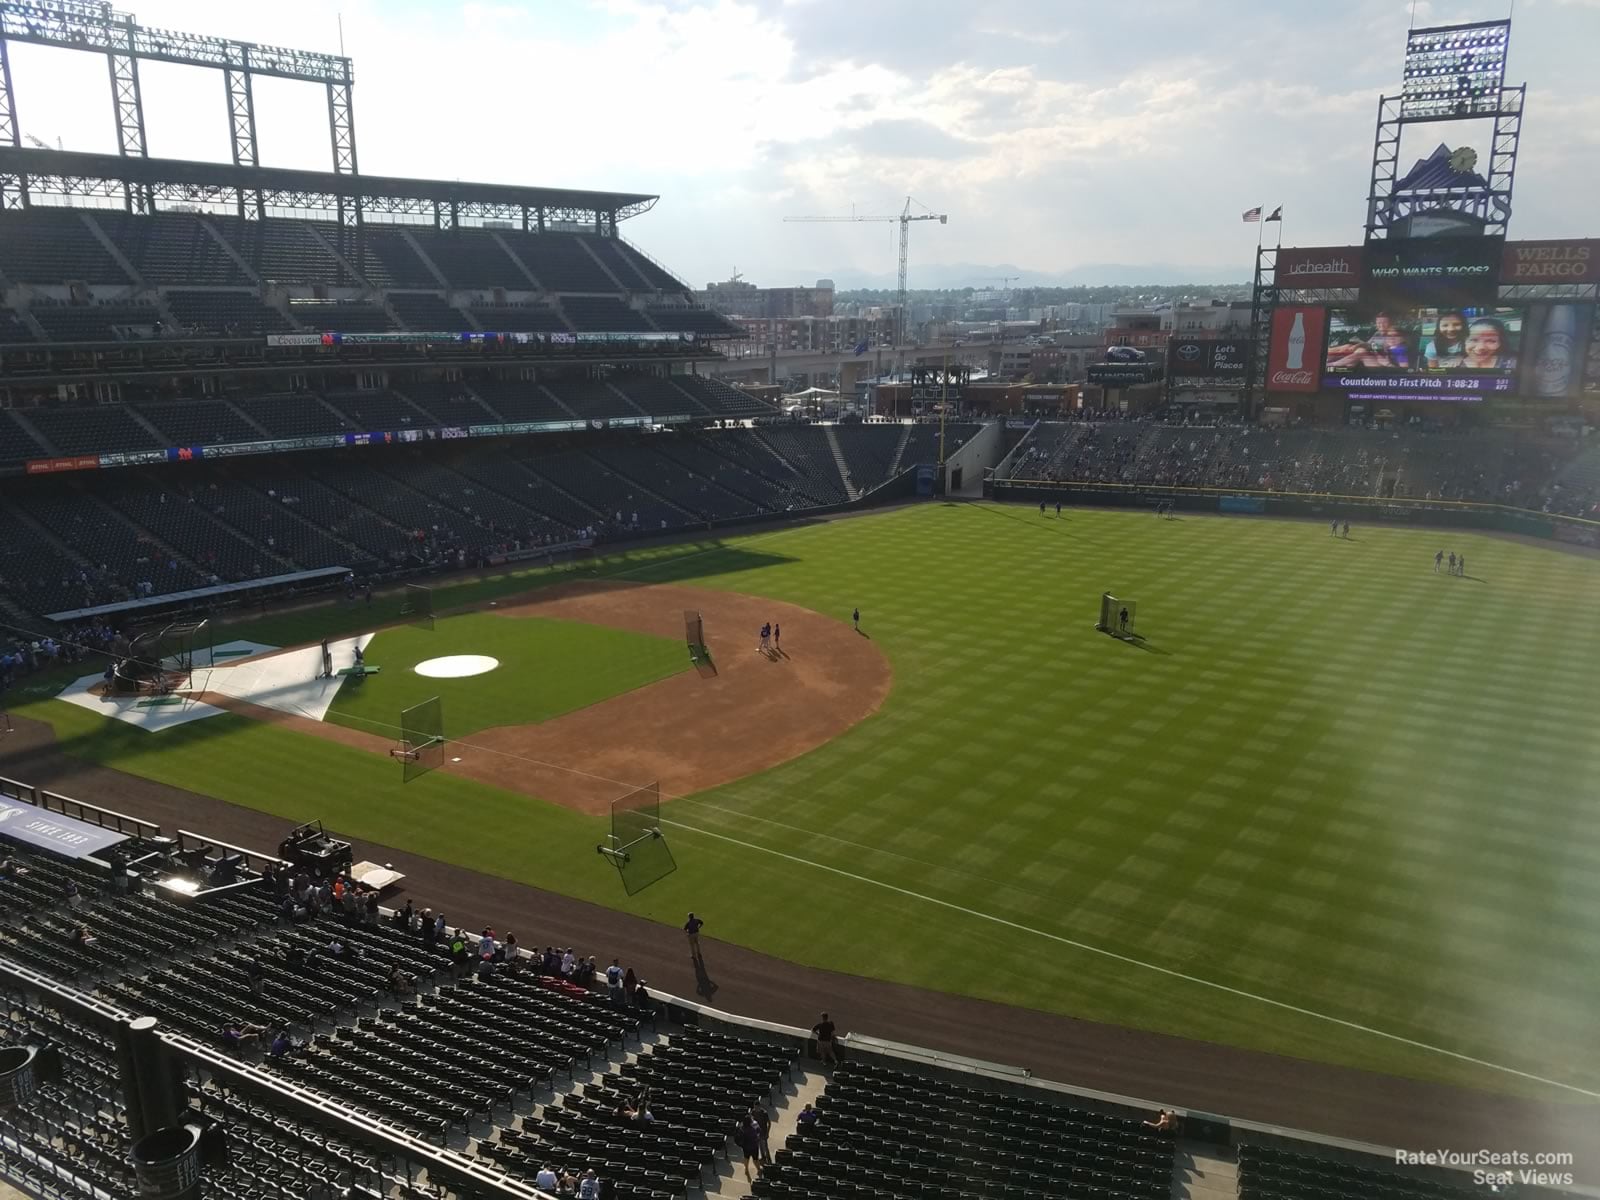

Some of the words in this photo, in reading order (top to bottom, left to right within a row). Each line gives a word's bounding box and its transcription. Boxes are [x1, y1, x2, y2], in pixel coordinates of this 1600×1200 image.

[1516, 247, 1590, 261] WELLS
[1289, 257, 1349, 273] uchealth
[1371, 267, 1400, 278] WHO
[1402, 266, 1443, 277] WANTS
[1446, 265, 1490, 276] TACOS?
[1514, 262, 1588, 276] FARGO
[301, 336, 321, 345] LIGHT
[1215, 344, 1237, 353] Let's
[1214, 353, 1228, 361] Go
[1214, 361, 1244, 369] Places
[1340, 376, 1387, 387] Countdown
[1388, 378, 1398, 387] to
[1399, 377, 1418, 388] First
[1419, 377, 1442, 388] Pitch
[1446, 379, 1480, 389] 1:08:28
[25, 821, 61, 836] SINCE
[56, 831, 89, 844] 1993
